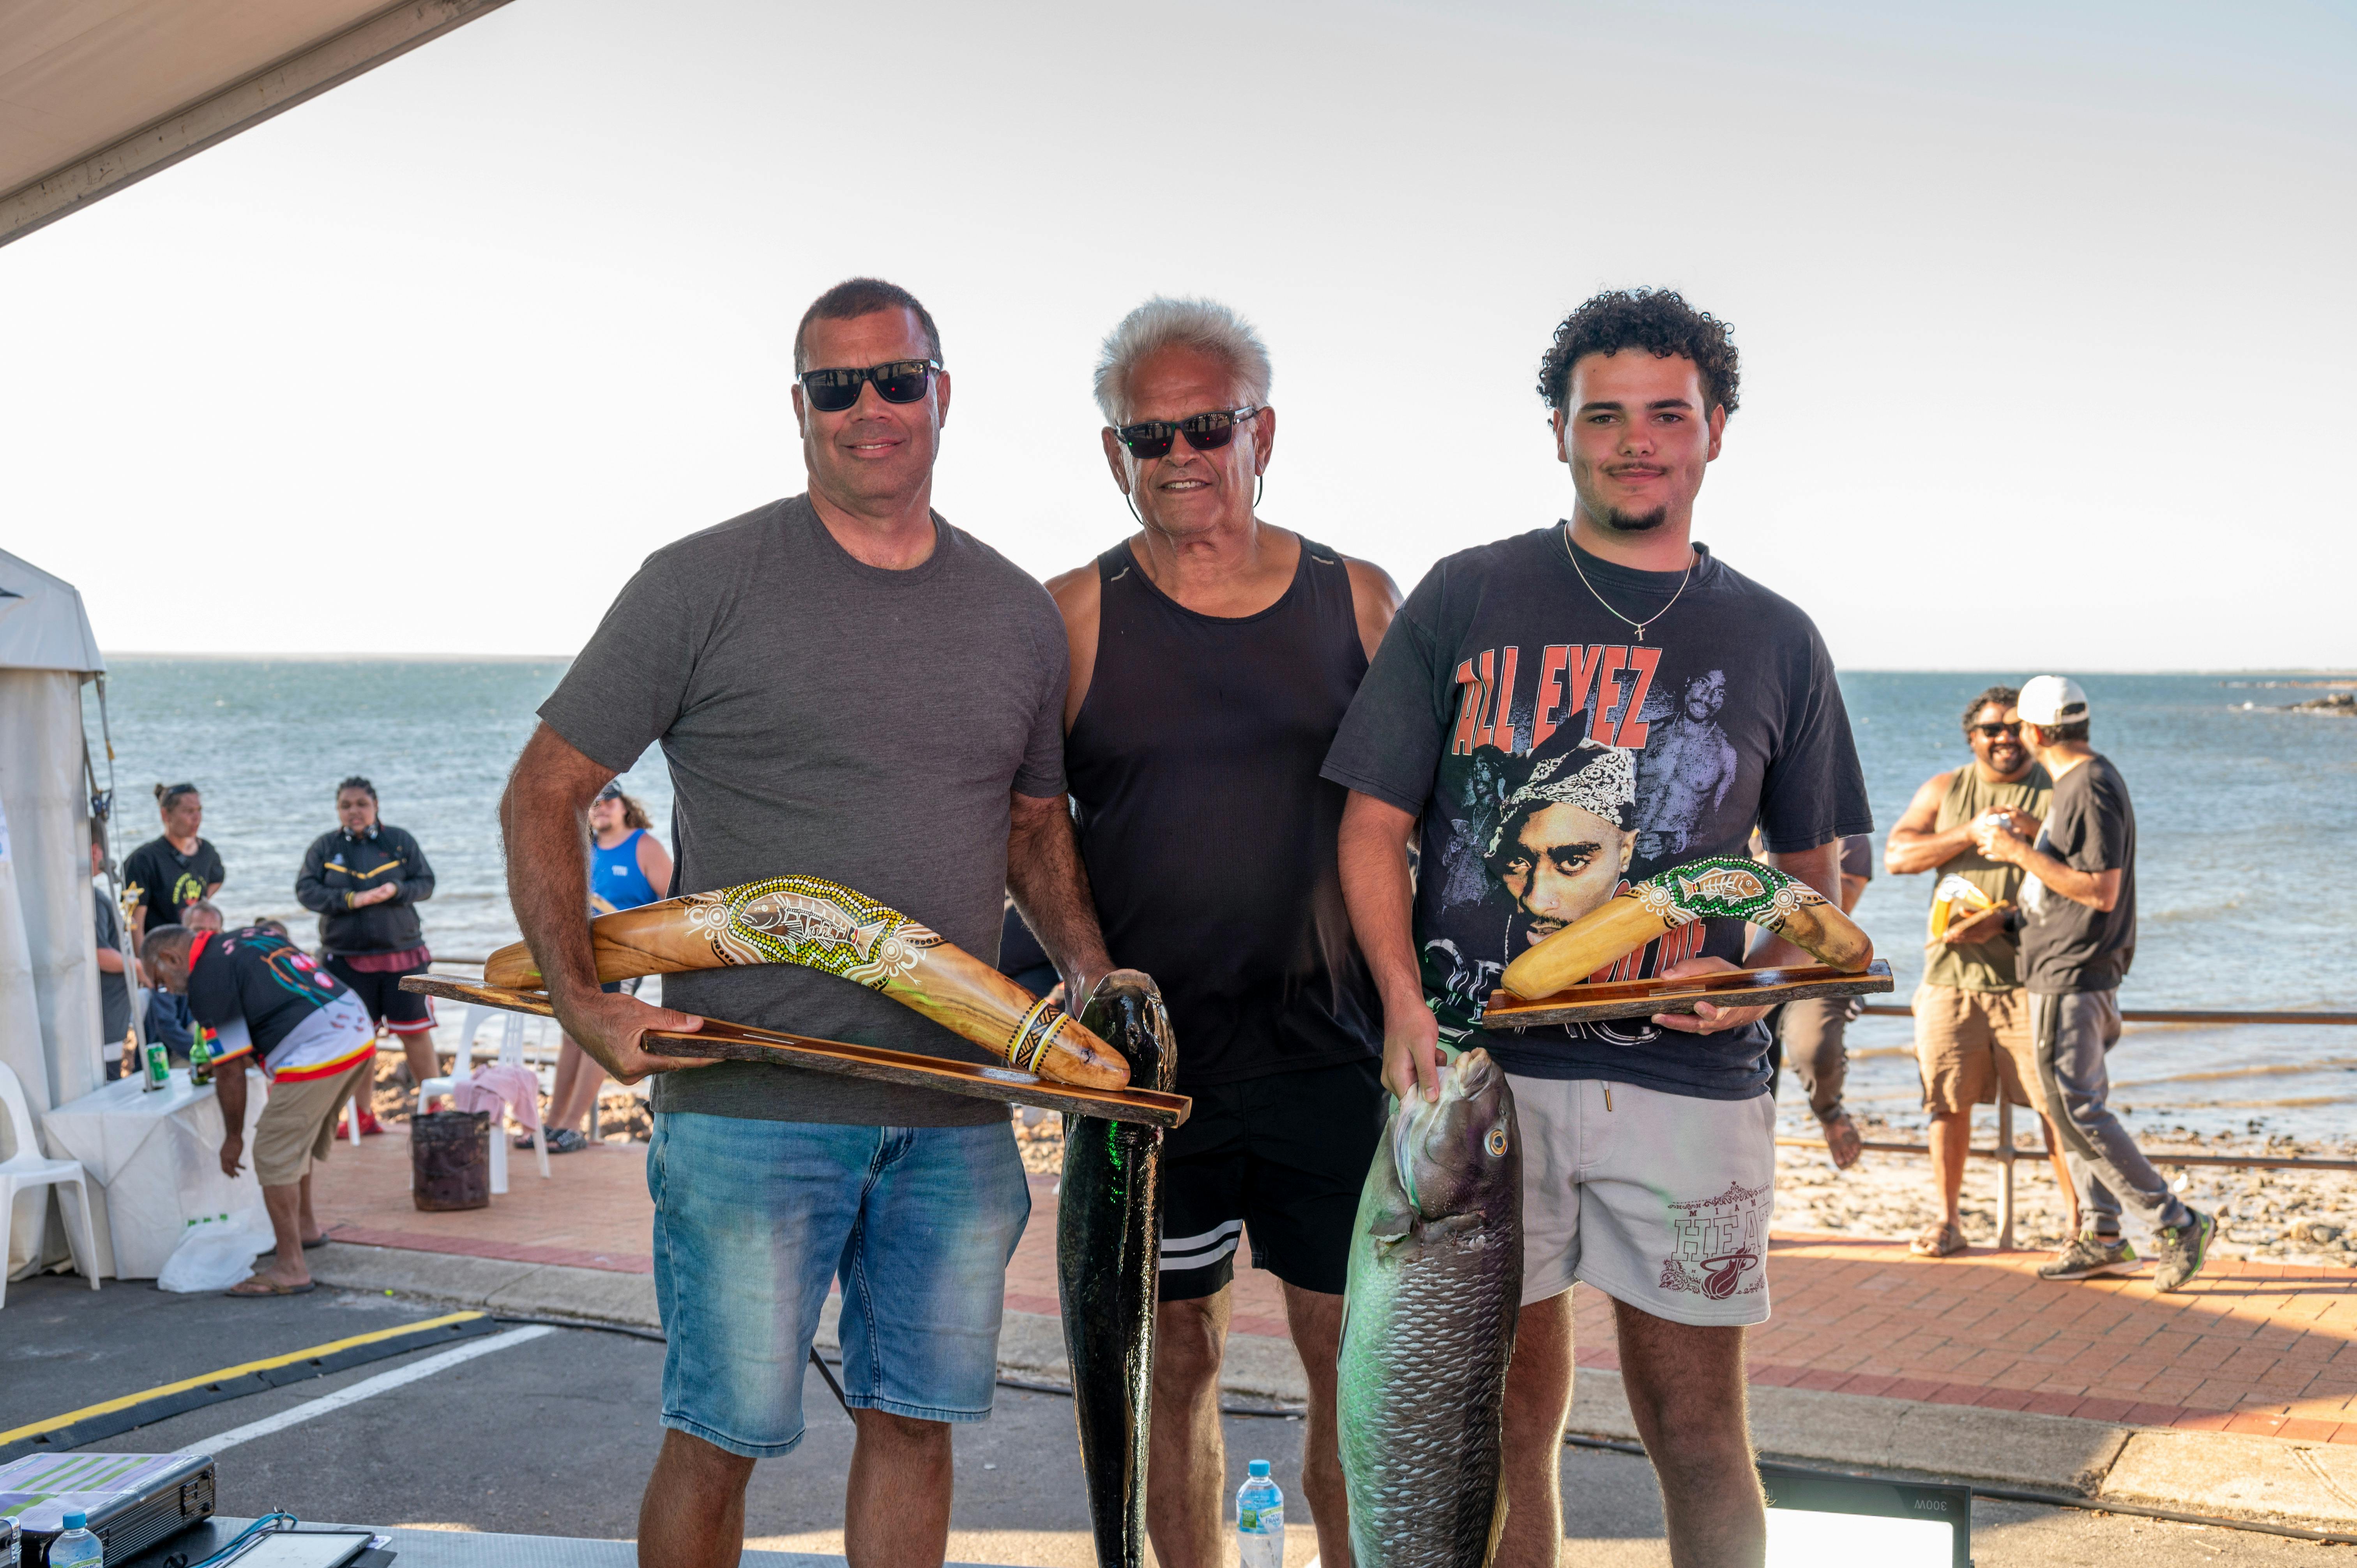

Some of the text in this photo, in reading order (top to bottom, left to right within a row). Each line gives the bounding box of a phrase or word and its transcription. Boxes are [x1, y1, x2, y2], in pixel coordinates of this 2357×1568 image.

[1451, 645, 1663, 755] ALL EYEZ
[1914, 1499, 1947, 1511] 300W
